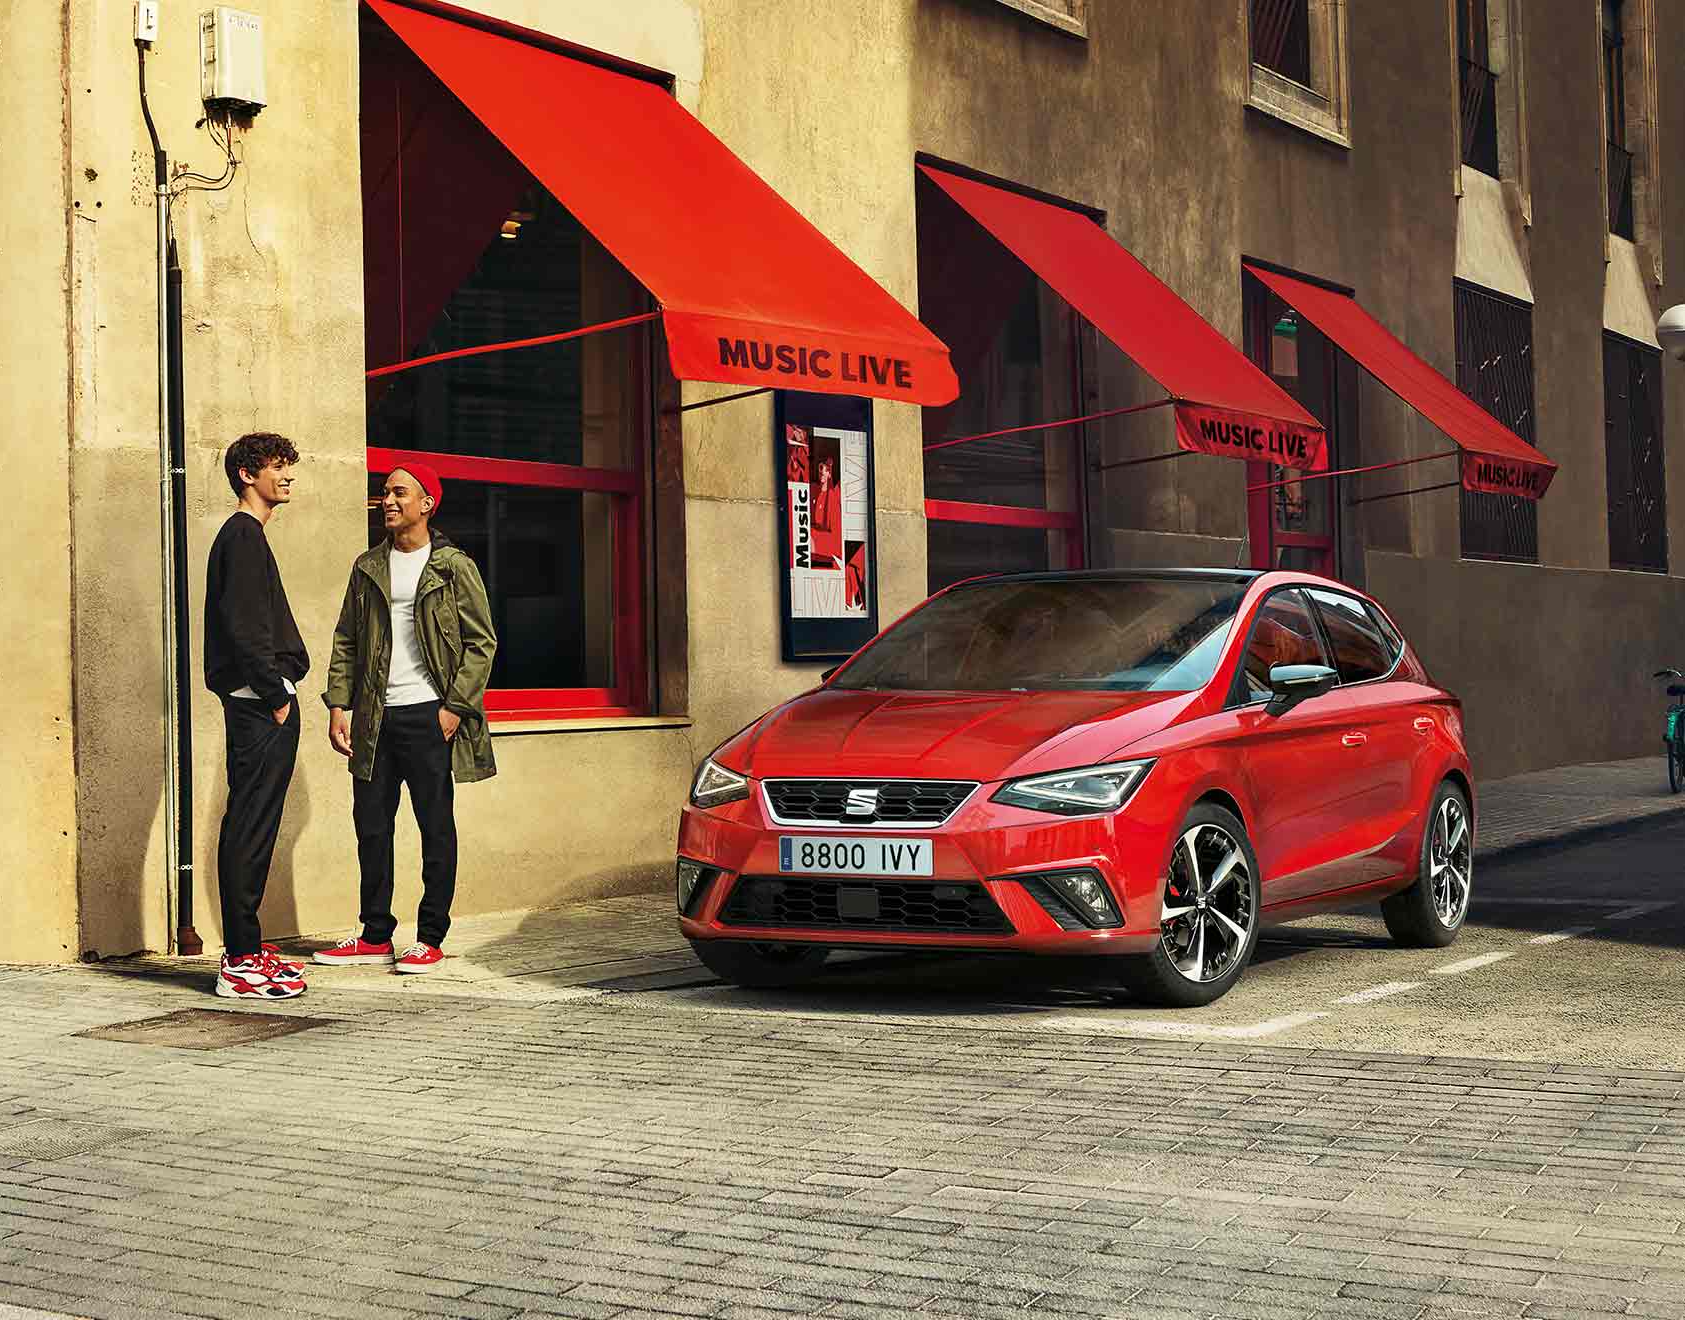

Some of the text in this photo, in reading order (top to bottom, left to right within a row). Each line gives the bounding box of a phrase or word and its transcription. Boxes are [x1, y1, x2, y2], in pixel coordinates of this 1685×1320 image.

[718, 337, 912, 389] MUSIC LIVE
[1200, 418, 1308, 459] MUSIC LIVE
[1478, 463, 1516, 487] MUSIC
[794, 489, 809, 568] Music
[801, 842, 920, 871] 8800 IVY
